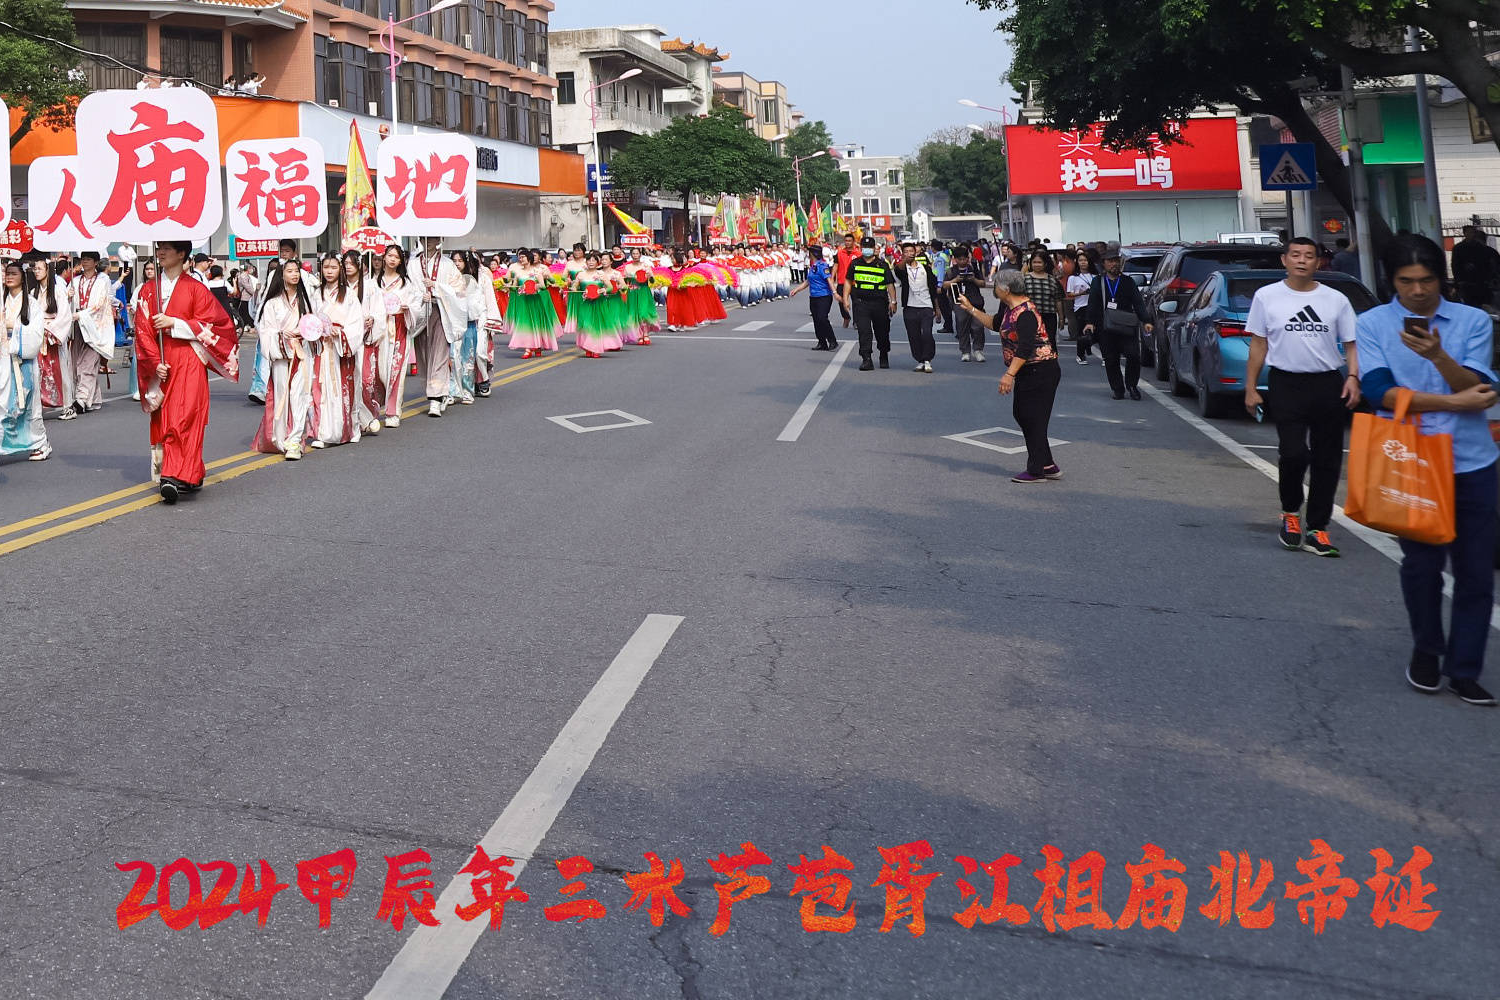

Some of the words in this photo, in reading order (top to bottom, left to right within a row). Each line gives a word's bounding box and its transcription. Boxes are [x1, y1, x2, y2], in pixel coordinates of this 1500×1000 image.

[95, 101, 209, 228] 庙
[235, 147, 320, 227] 福
[384, 154, 469, 220] 地
[1060, 156, 1173, 191] 找一鸣
[1284, 321, 1330, 333] adidas
